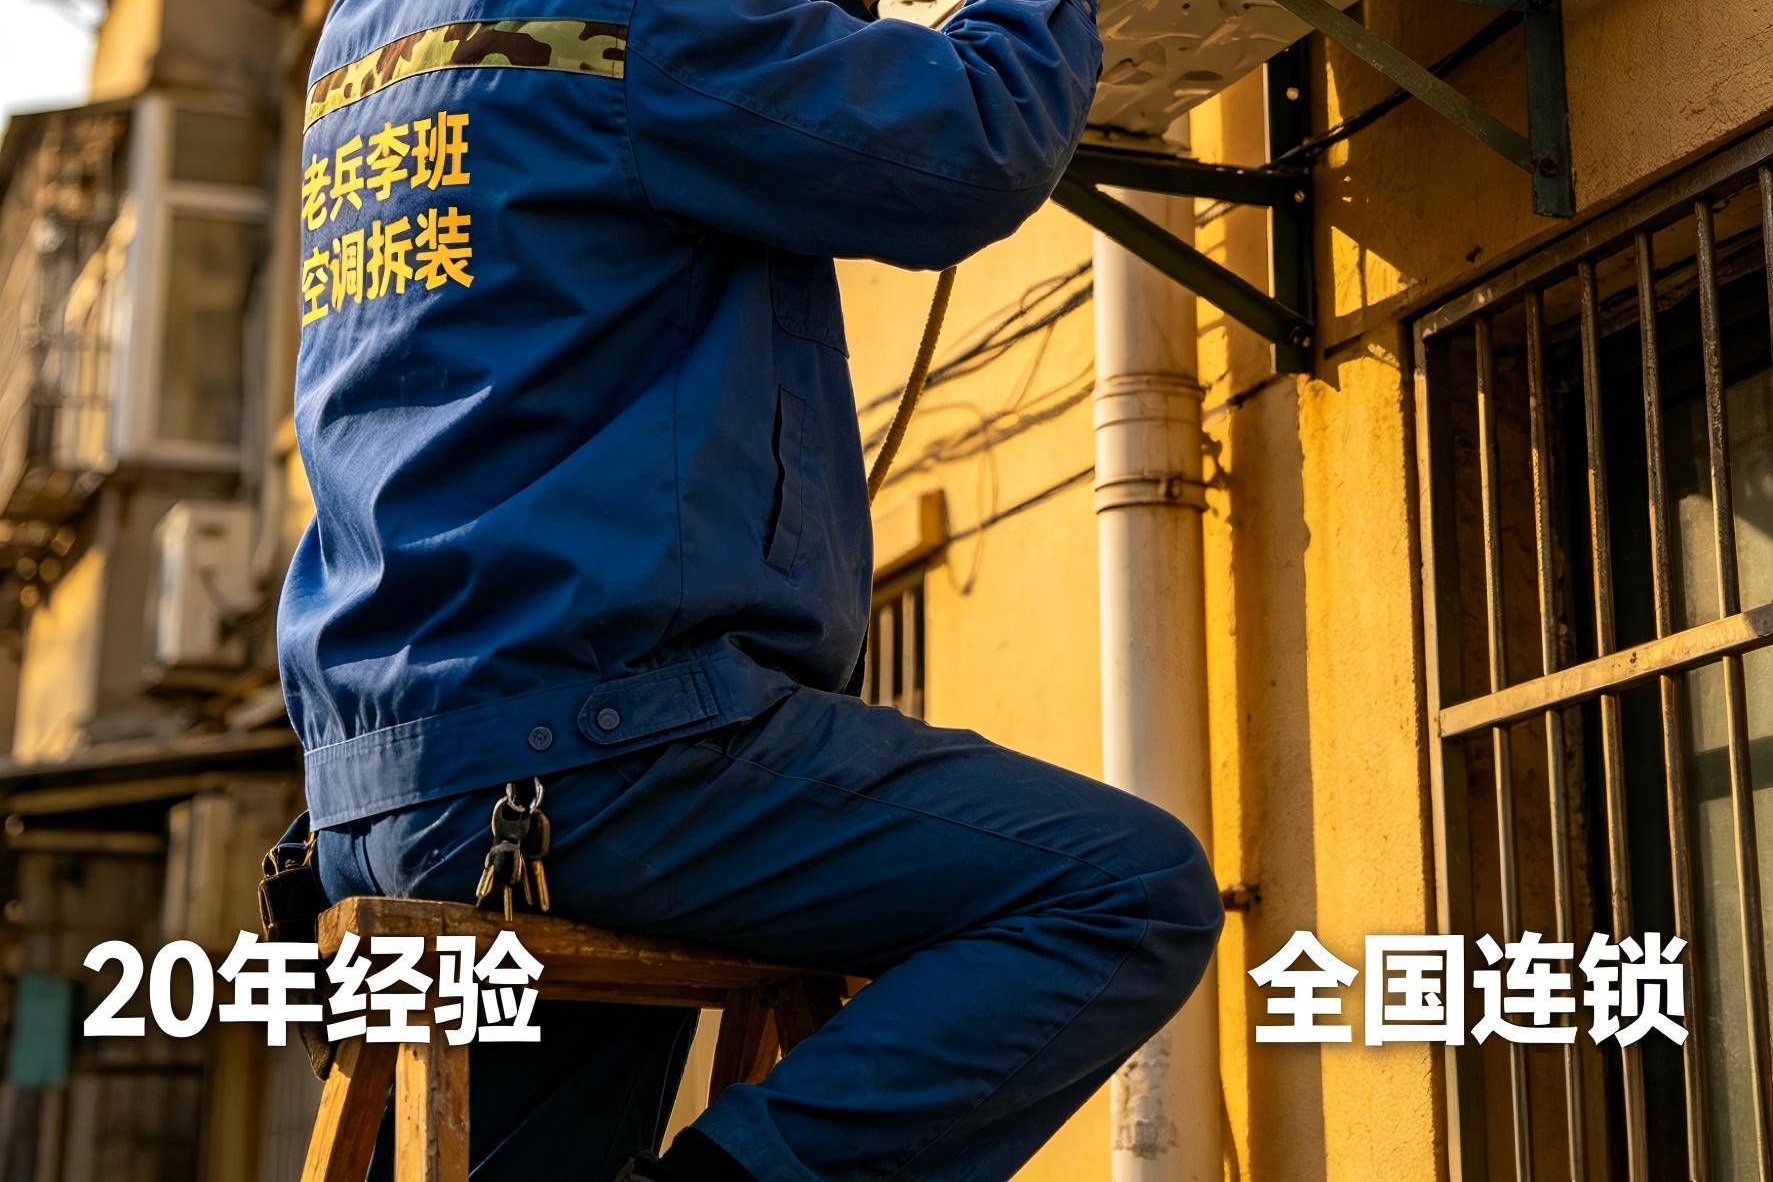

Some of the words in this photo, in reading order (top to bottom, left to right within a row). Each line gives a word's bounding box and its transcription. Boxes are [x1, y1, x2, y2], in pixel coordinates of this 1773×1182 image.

[301, 111, 471, 230] 老兵李班
[301, 207, 475, 327] 空调拆装
